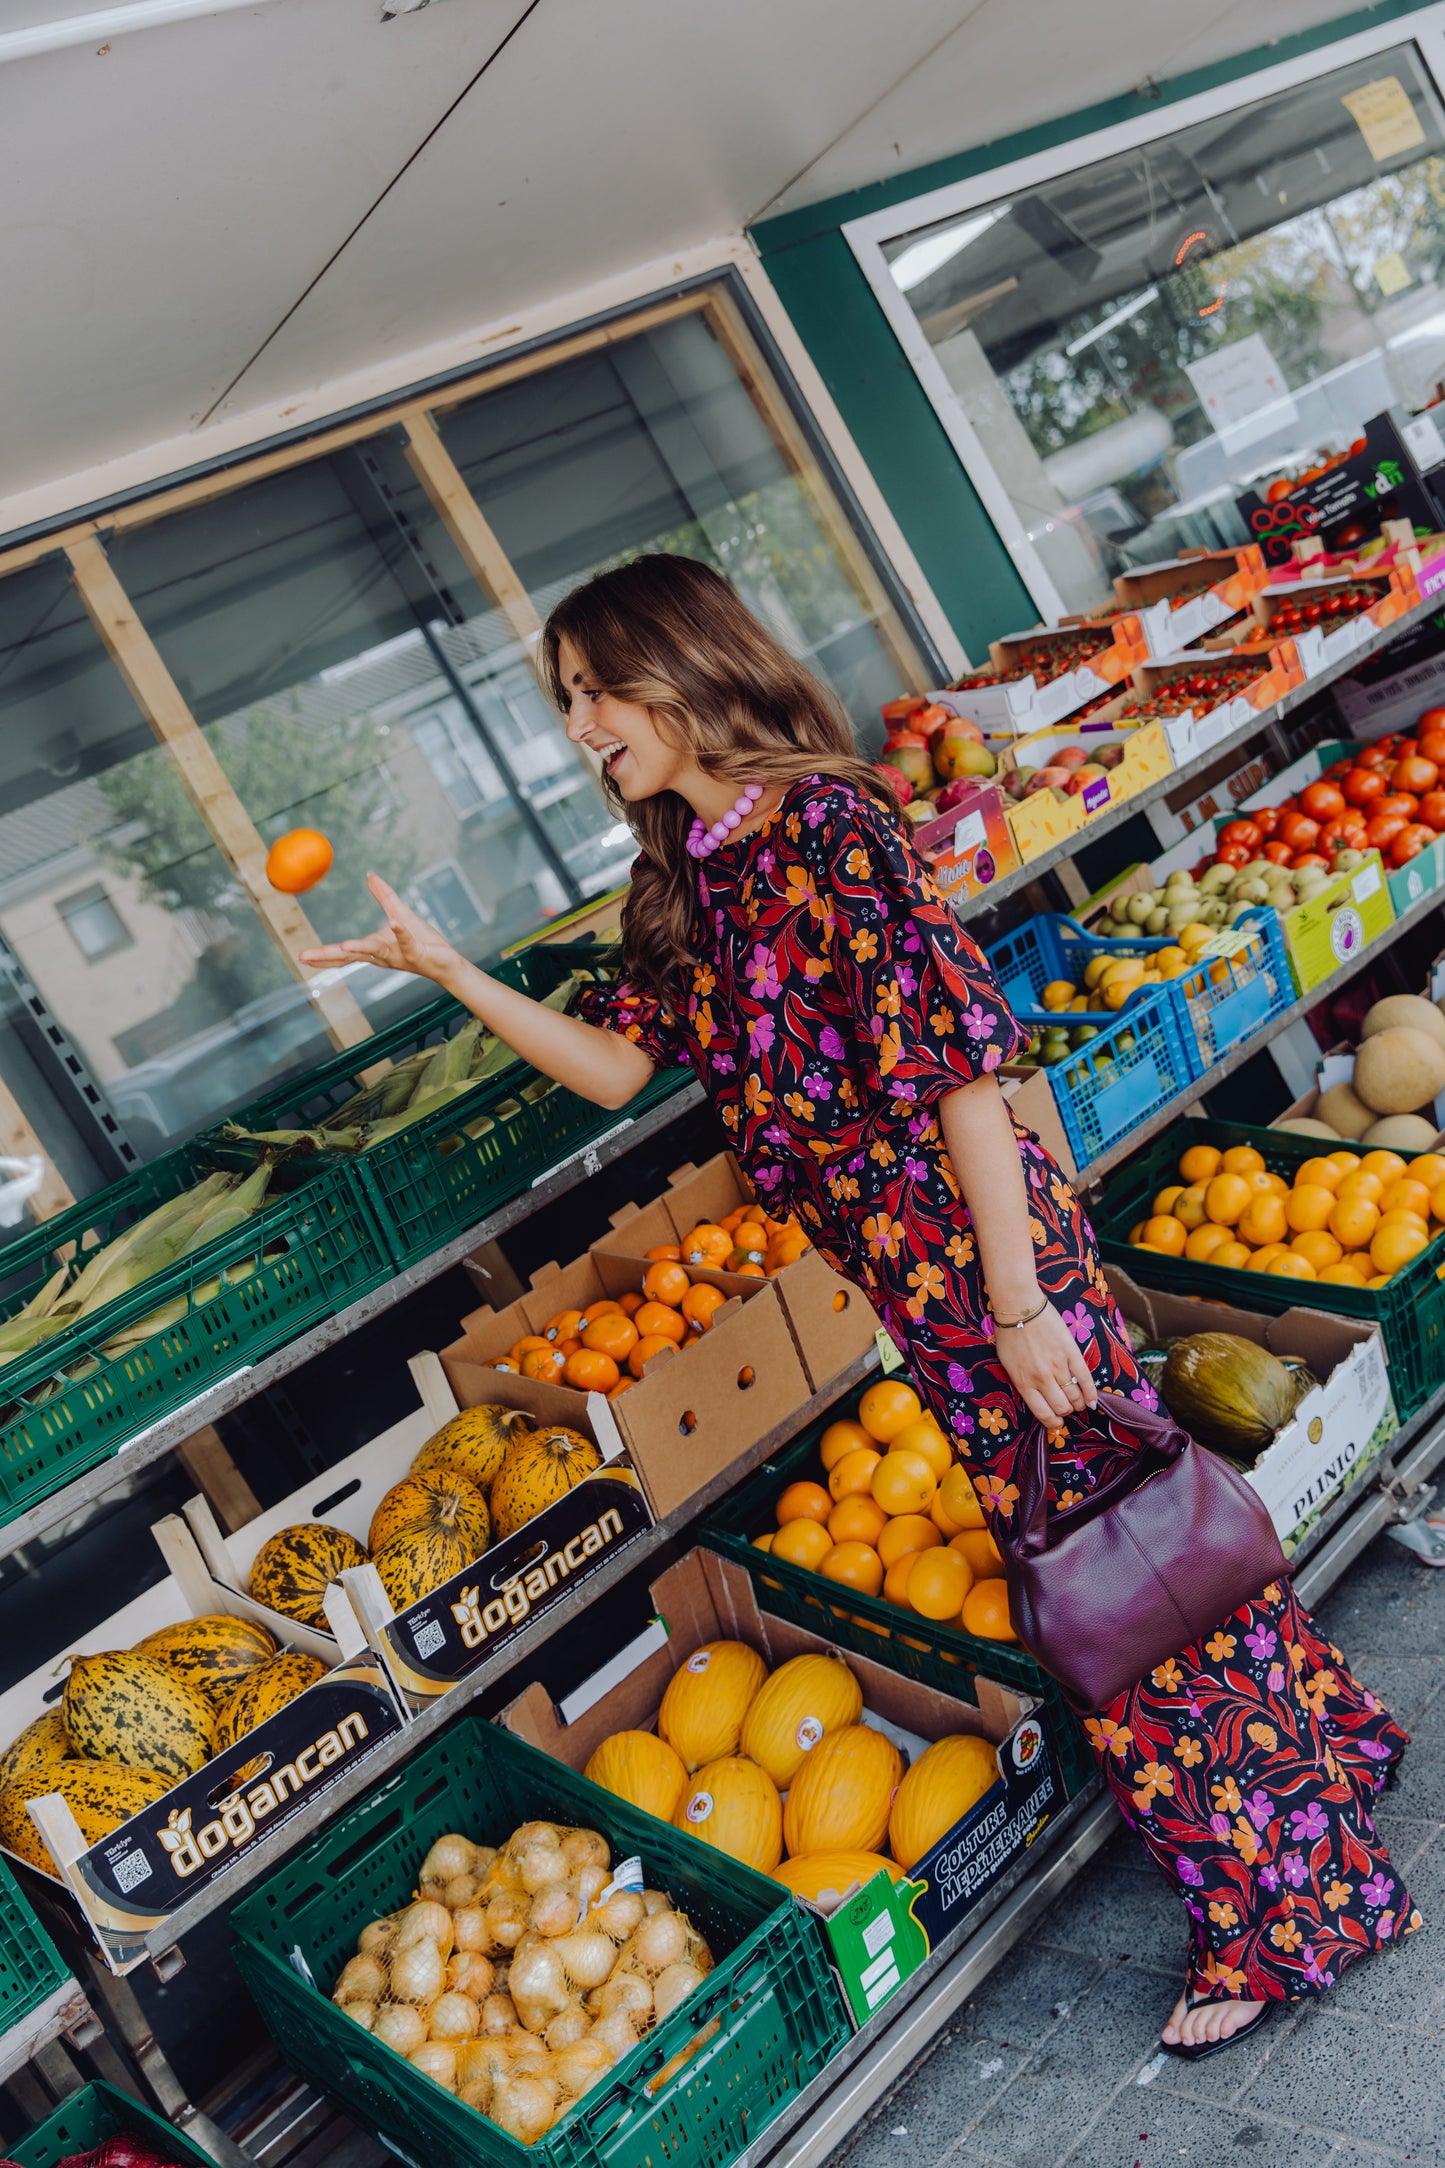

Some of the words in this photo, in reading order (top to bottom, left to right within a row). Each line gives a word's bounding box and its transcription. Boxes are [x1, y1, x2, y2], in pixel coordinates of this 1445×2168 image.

[1324, 492, 1358, 516] Tomato
[1293, 1442, 1356, 1521] PLINIO
[103, 1835, 133, 1858] Türkiye
[935, 1801, 1008, 1884] COLTURE
[971, 1869, 990, 1892] vero
[990, 1848, 1012, 1876] gusto
[1022, 1816, 1038, 1837] sole
